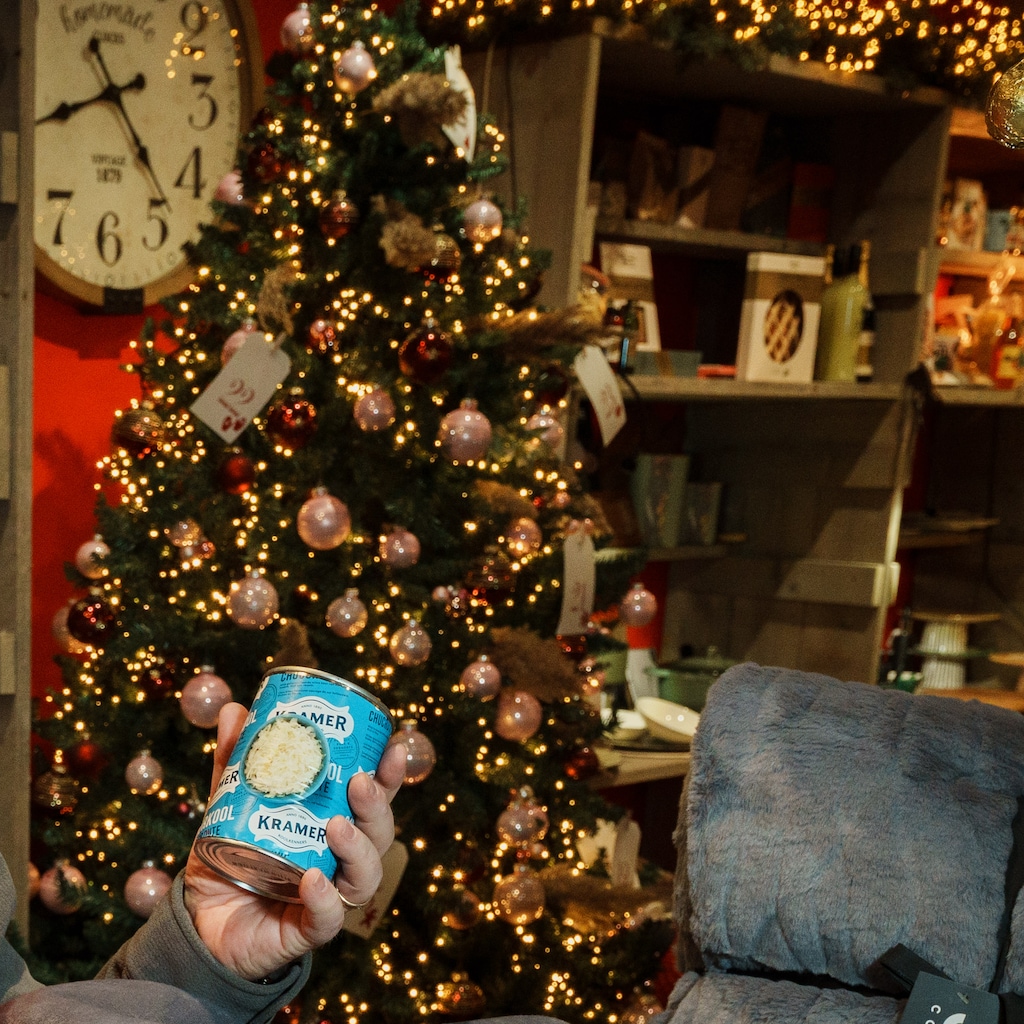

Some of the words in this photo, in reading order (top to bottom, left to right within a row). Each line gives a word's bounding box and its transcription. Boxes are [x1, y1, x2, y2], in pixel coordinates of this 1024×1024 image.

[187, 73, 218, 131] 3
[173, 146, 206, 199] 4
[46, 190, 74, 245] 7
[96, 211, 123, 268] 6
[142, 198, 168, 251] 5
[276, 710, 347, 732] AMER
[257, 814, 327, 844] KRAMER
